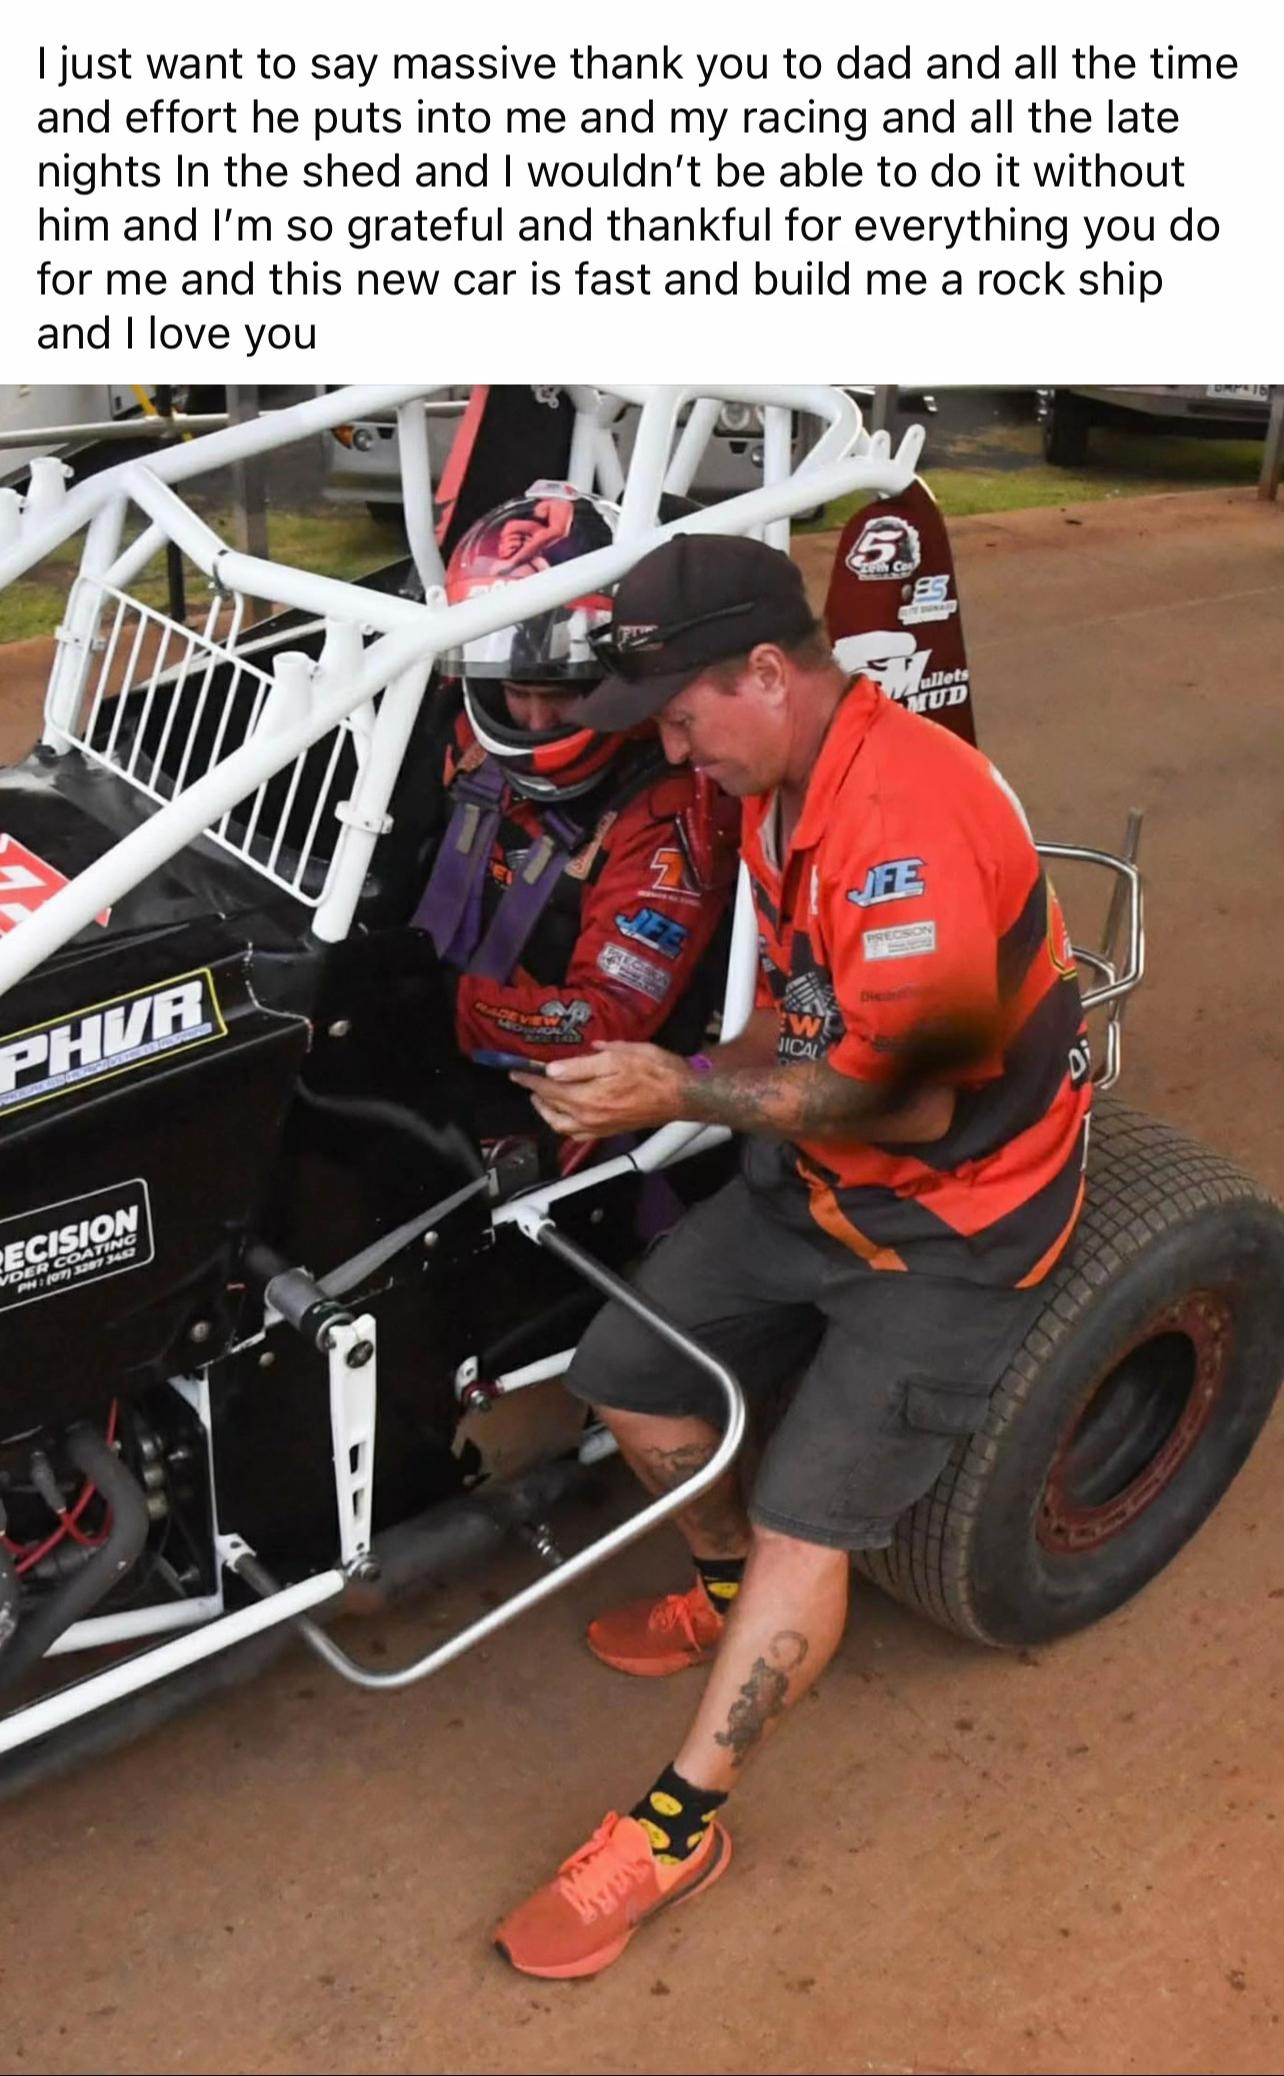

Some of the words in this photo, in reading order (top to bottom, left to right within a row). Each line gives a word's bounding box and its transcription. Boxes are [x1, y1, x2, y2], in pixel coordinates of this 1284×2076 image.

[849, 530, 904, 568] 5
[907, 685, 969, 712] MUD
[848, 858, 926, 905] JFE
[0, 980, 204, 1095] PHVR
[0, 1204, 139, 1275] ECISION
[53, 1233, 137, 1268] COATING
[46, 1268, 72, 1286] (07)
[73, 1257, 104, 1275] 3287
[105, 1247, 137, 1265] 3452
